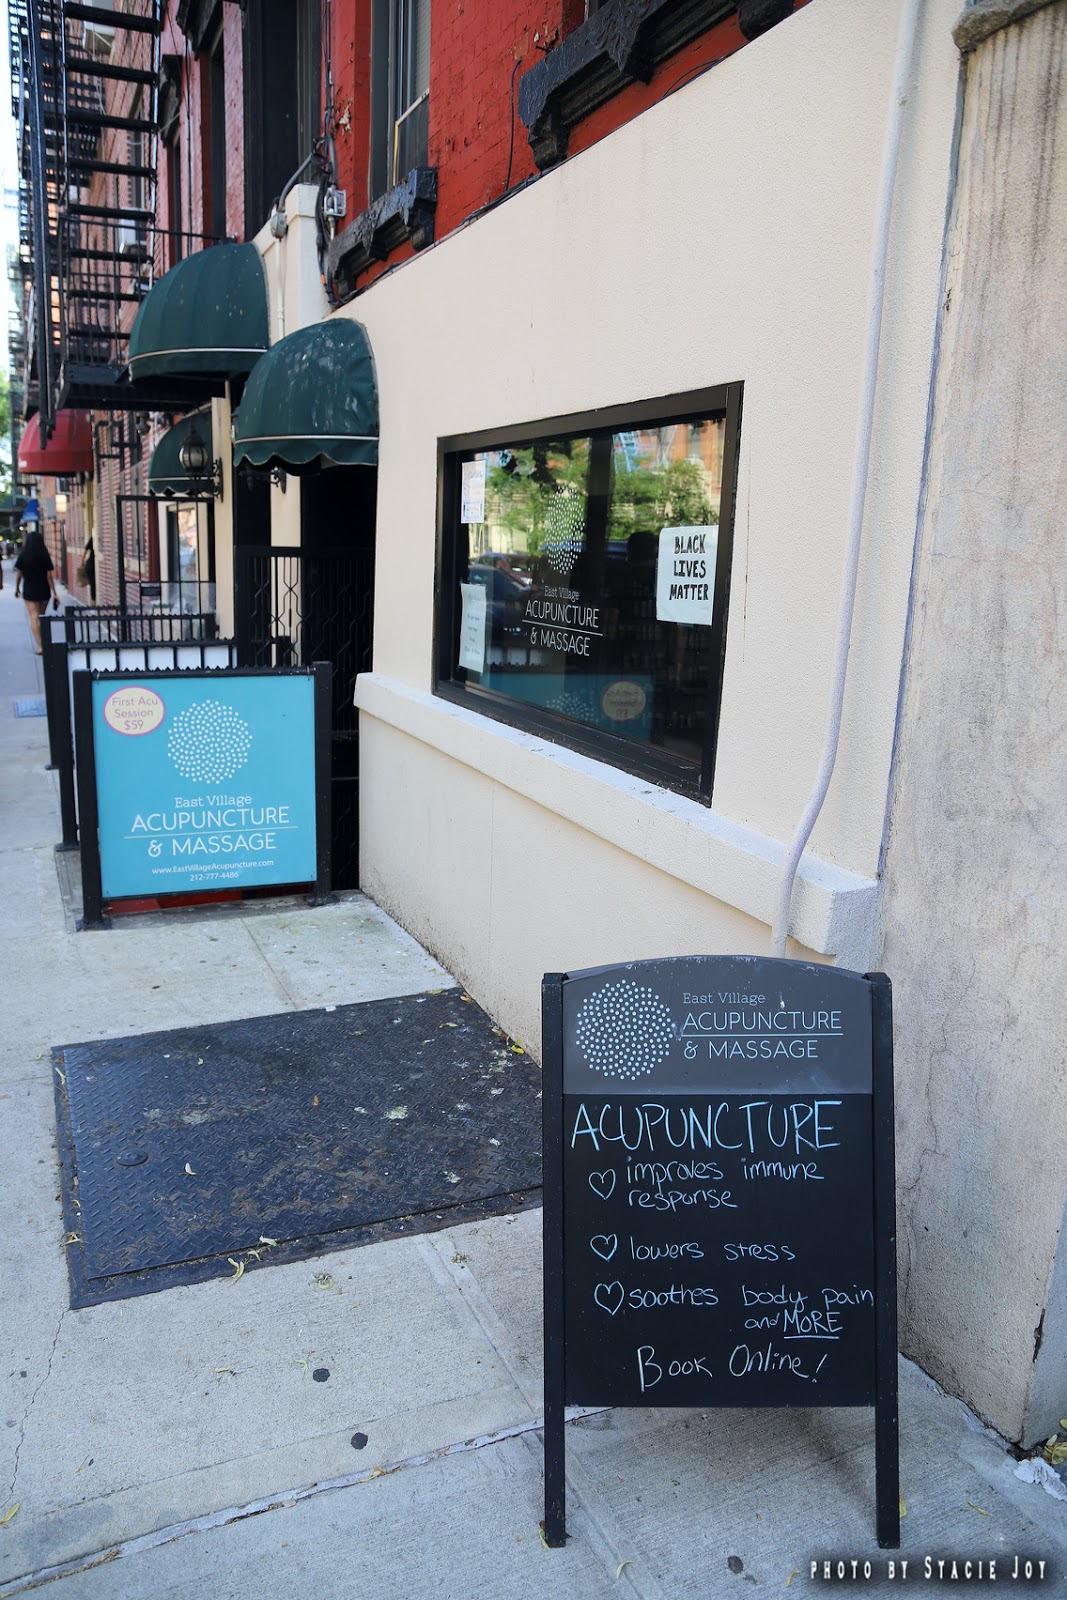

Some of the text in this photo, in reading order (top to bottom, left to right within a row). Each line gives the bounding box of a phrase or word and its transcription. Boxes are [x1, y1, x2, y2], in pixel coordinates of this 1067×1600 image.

[674, 533, 706, 554] BLACK
[673, 560, 707, 578] LIVES
[544, 585, 580, 602] East Village
[669, 583, 709, 601] MATTER
[525, 600, 600, 628] ACUPUNCTURE
[530, 627, 590, 657] & MASSAGE
[112, 695, 158, 706] First Acu
[114, 708, 154, 718] Session
[124, 720, 144, 731] $59
[175, 794, 253, 809] East Village
[131, 806, 290, 833] ACUPUNCTURE
[147, 832, 277, 858] & MASSAGE
[151, 860, 275, 874] www.EastVillageAcupuncture.com
[189, 872, 239, 882] 212-777-4486
[683, 992, 766, 1005] East Village
[682, 1011, 843, 1030] ACUPUNCTURE
[683, 1040, 818, 1059] & MASSAGE
[570, 1100, 843, 1154] ACUPUNCTURE
[625, 1155, 825, 1188] improves immune
[628, 1187, 738, 1212] response
[629, 1236, 796, 1261] lowers stress
[628, 1284, 875, 1312] soothes body pain
[744, 1308, 844, 1333] and MORE
[636, 1345, 713, 1392] Book
